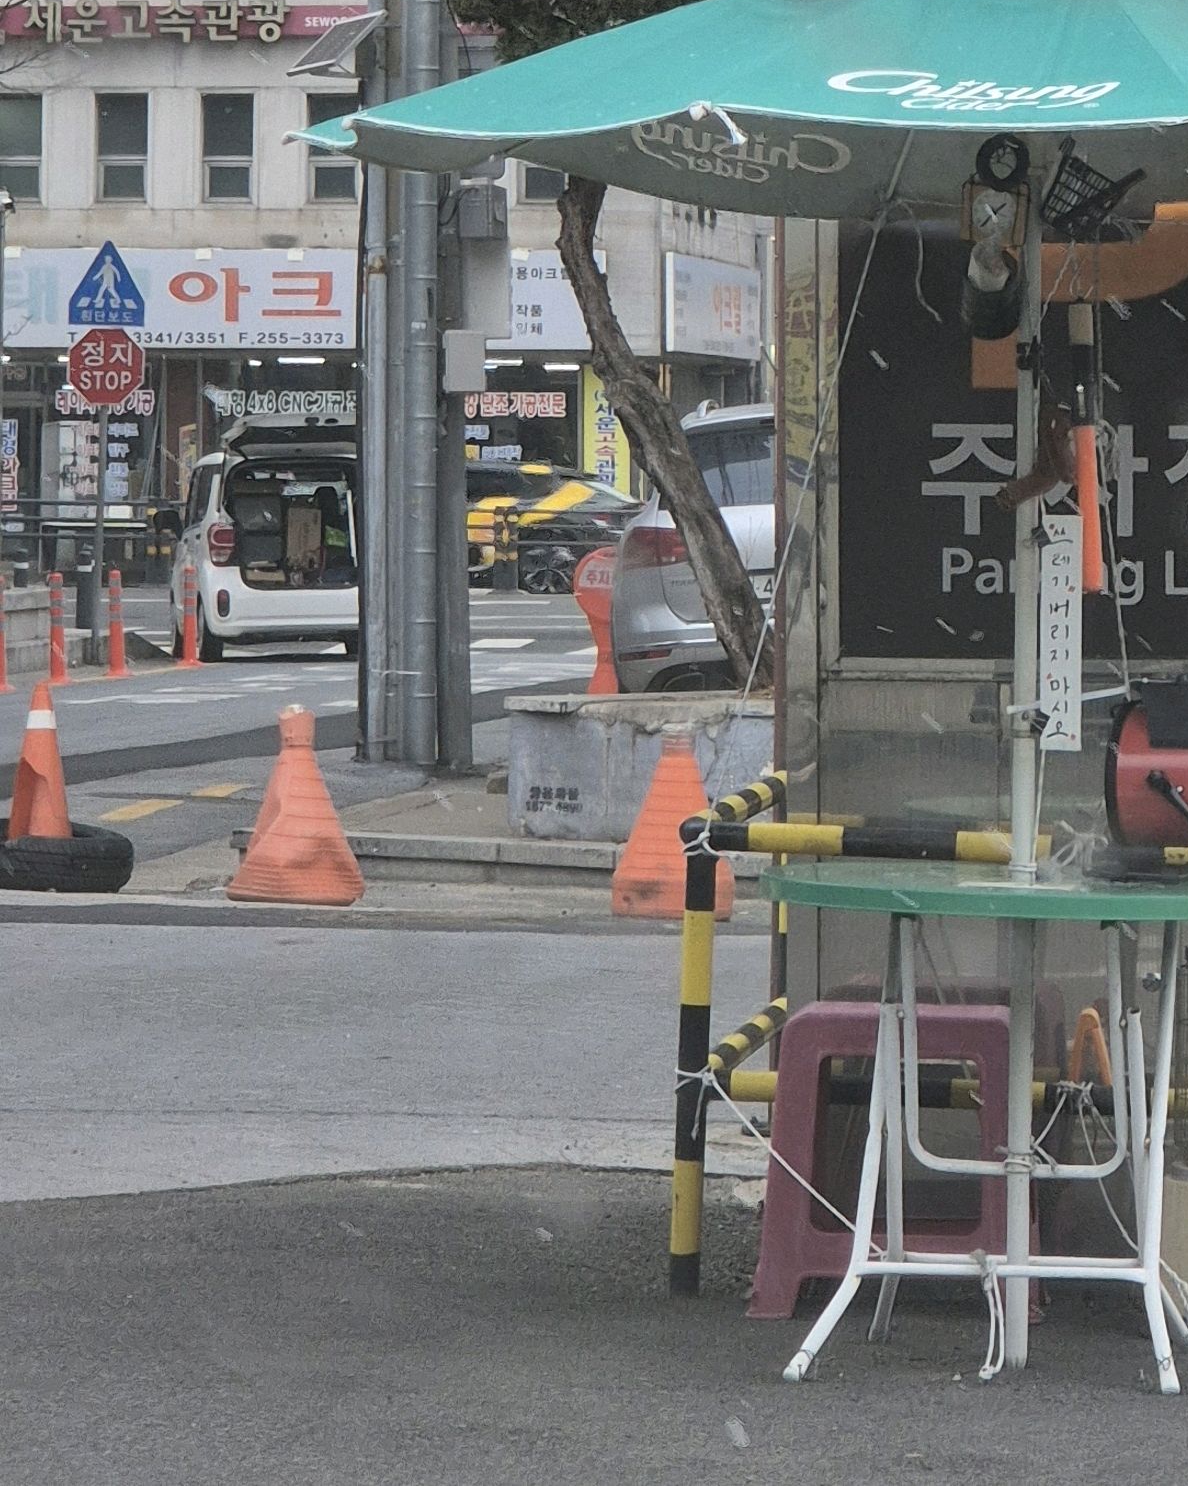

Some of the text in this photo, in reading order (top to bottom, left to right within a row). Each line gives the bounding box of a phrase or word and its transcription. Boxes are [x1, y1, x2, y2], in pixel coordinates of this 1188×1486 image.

[827, 70, 1121, 110] Chilsung
[238, 330, 345, 345] F.255-3373
[80, 340, 133, 367] 정지
[79, 370, 132, 391] STOP
